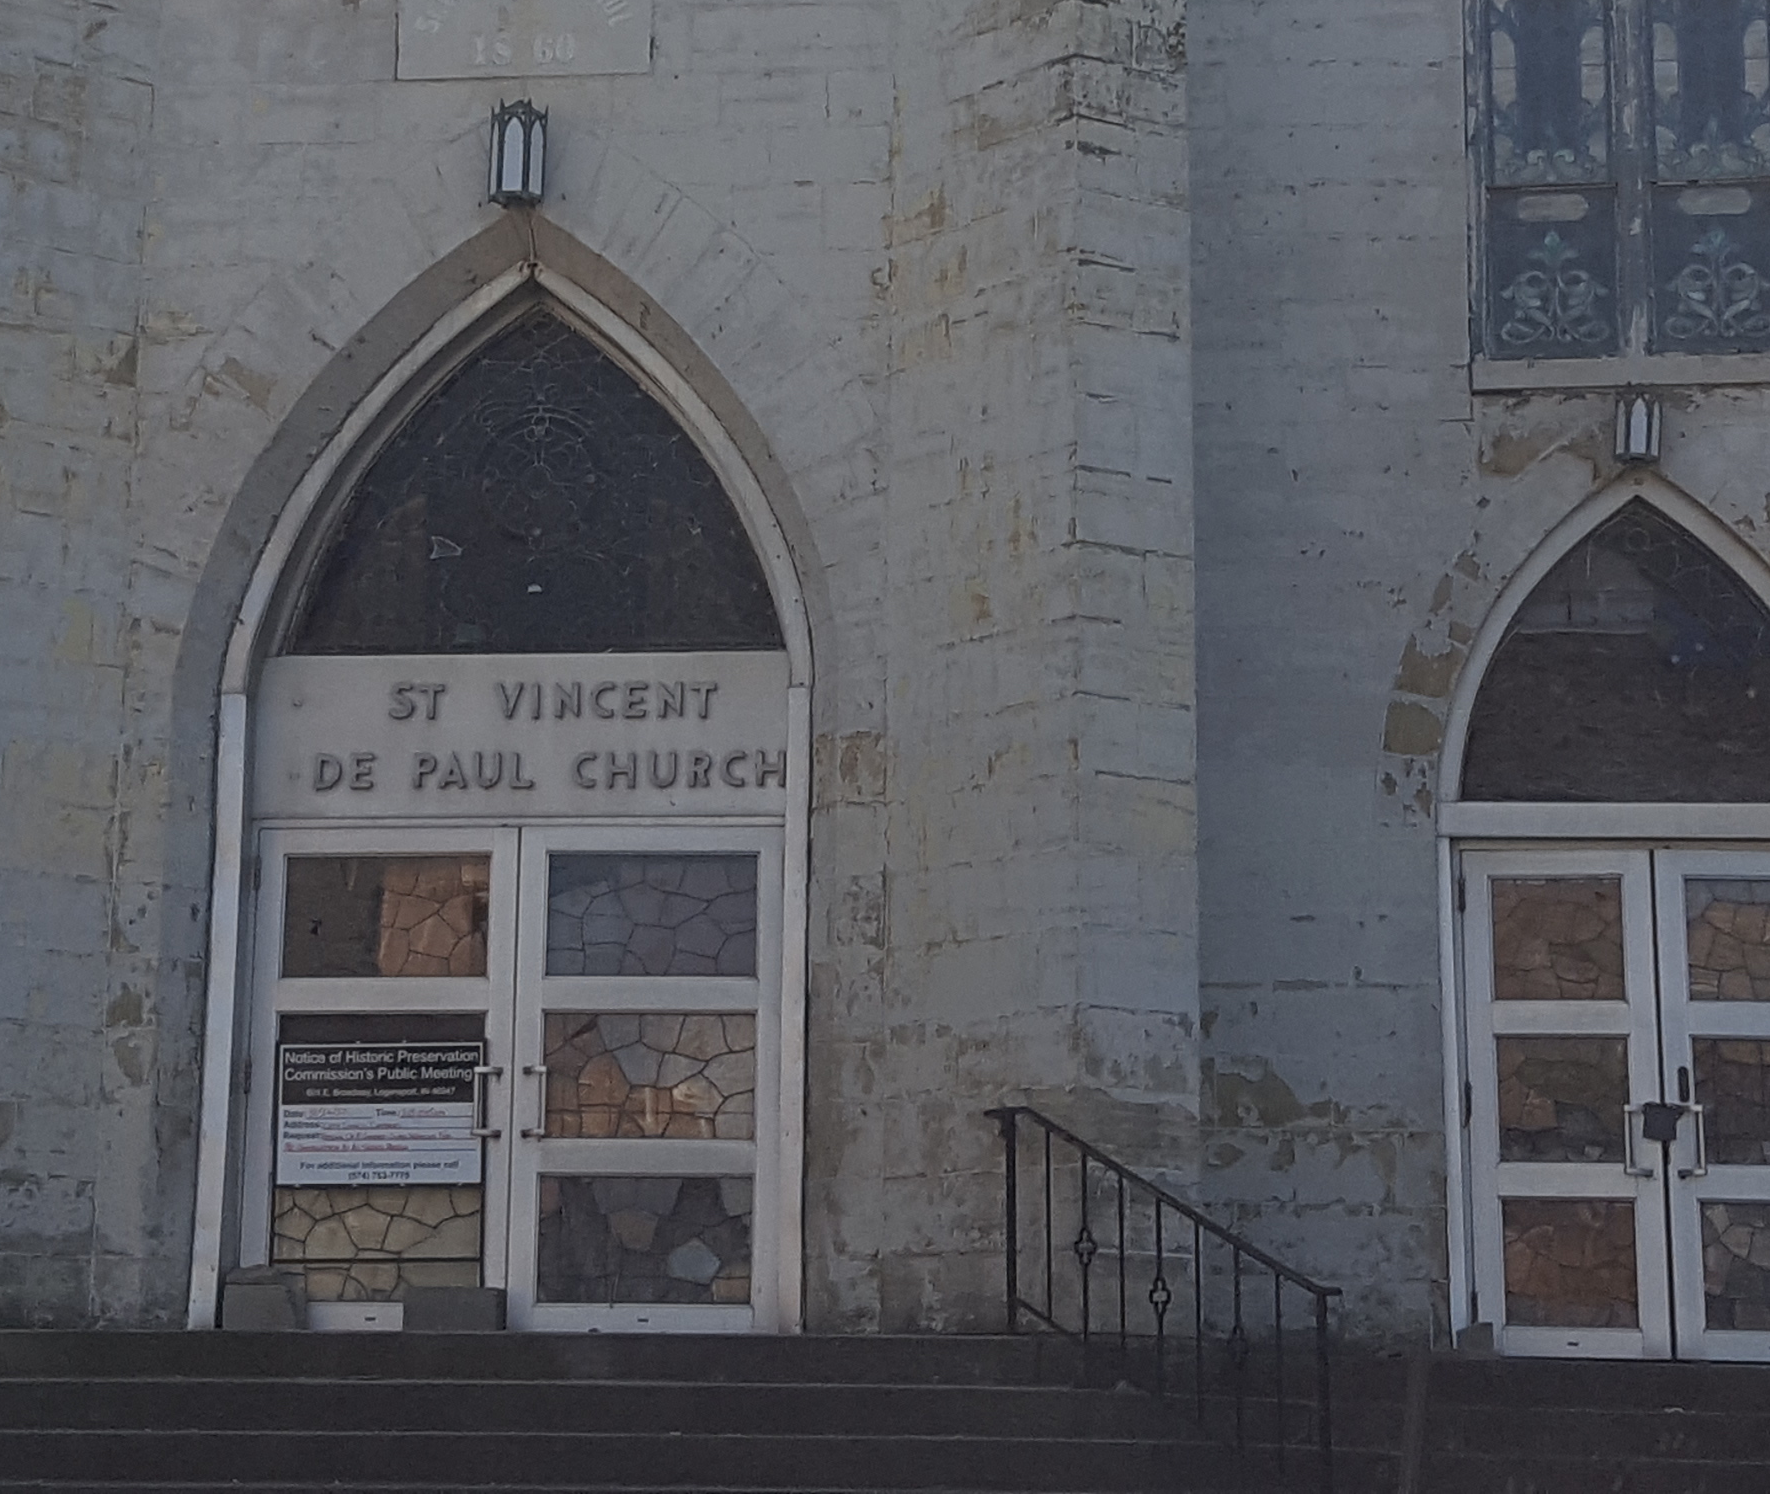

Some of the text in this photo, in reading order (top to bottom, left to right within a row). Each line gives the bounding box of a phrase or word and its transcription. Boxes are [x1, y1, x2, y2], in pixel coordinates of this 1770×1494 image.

[387, 680, 719, 721] ST VINCENT
[314, 748, 787, 793] DE PAUL CHURCH
[285, 1049, 479, 1064] Notice of Historic Preservation
[285, 1066, 473, 1082] Commission's Public Meeting
